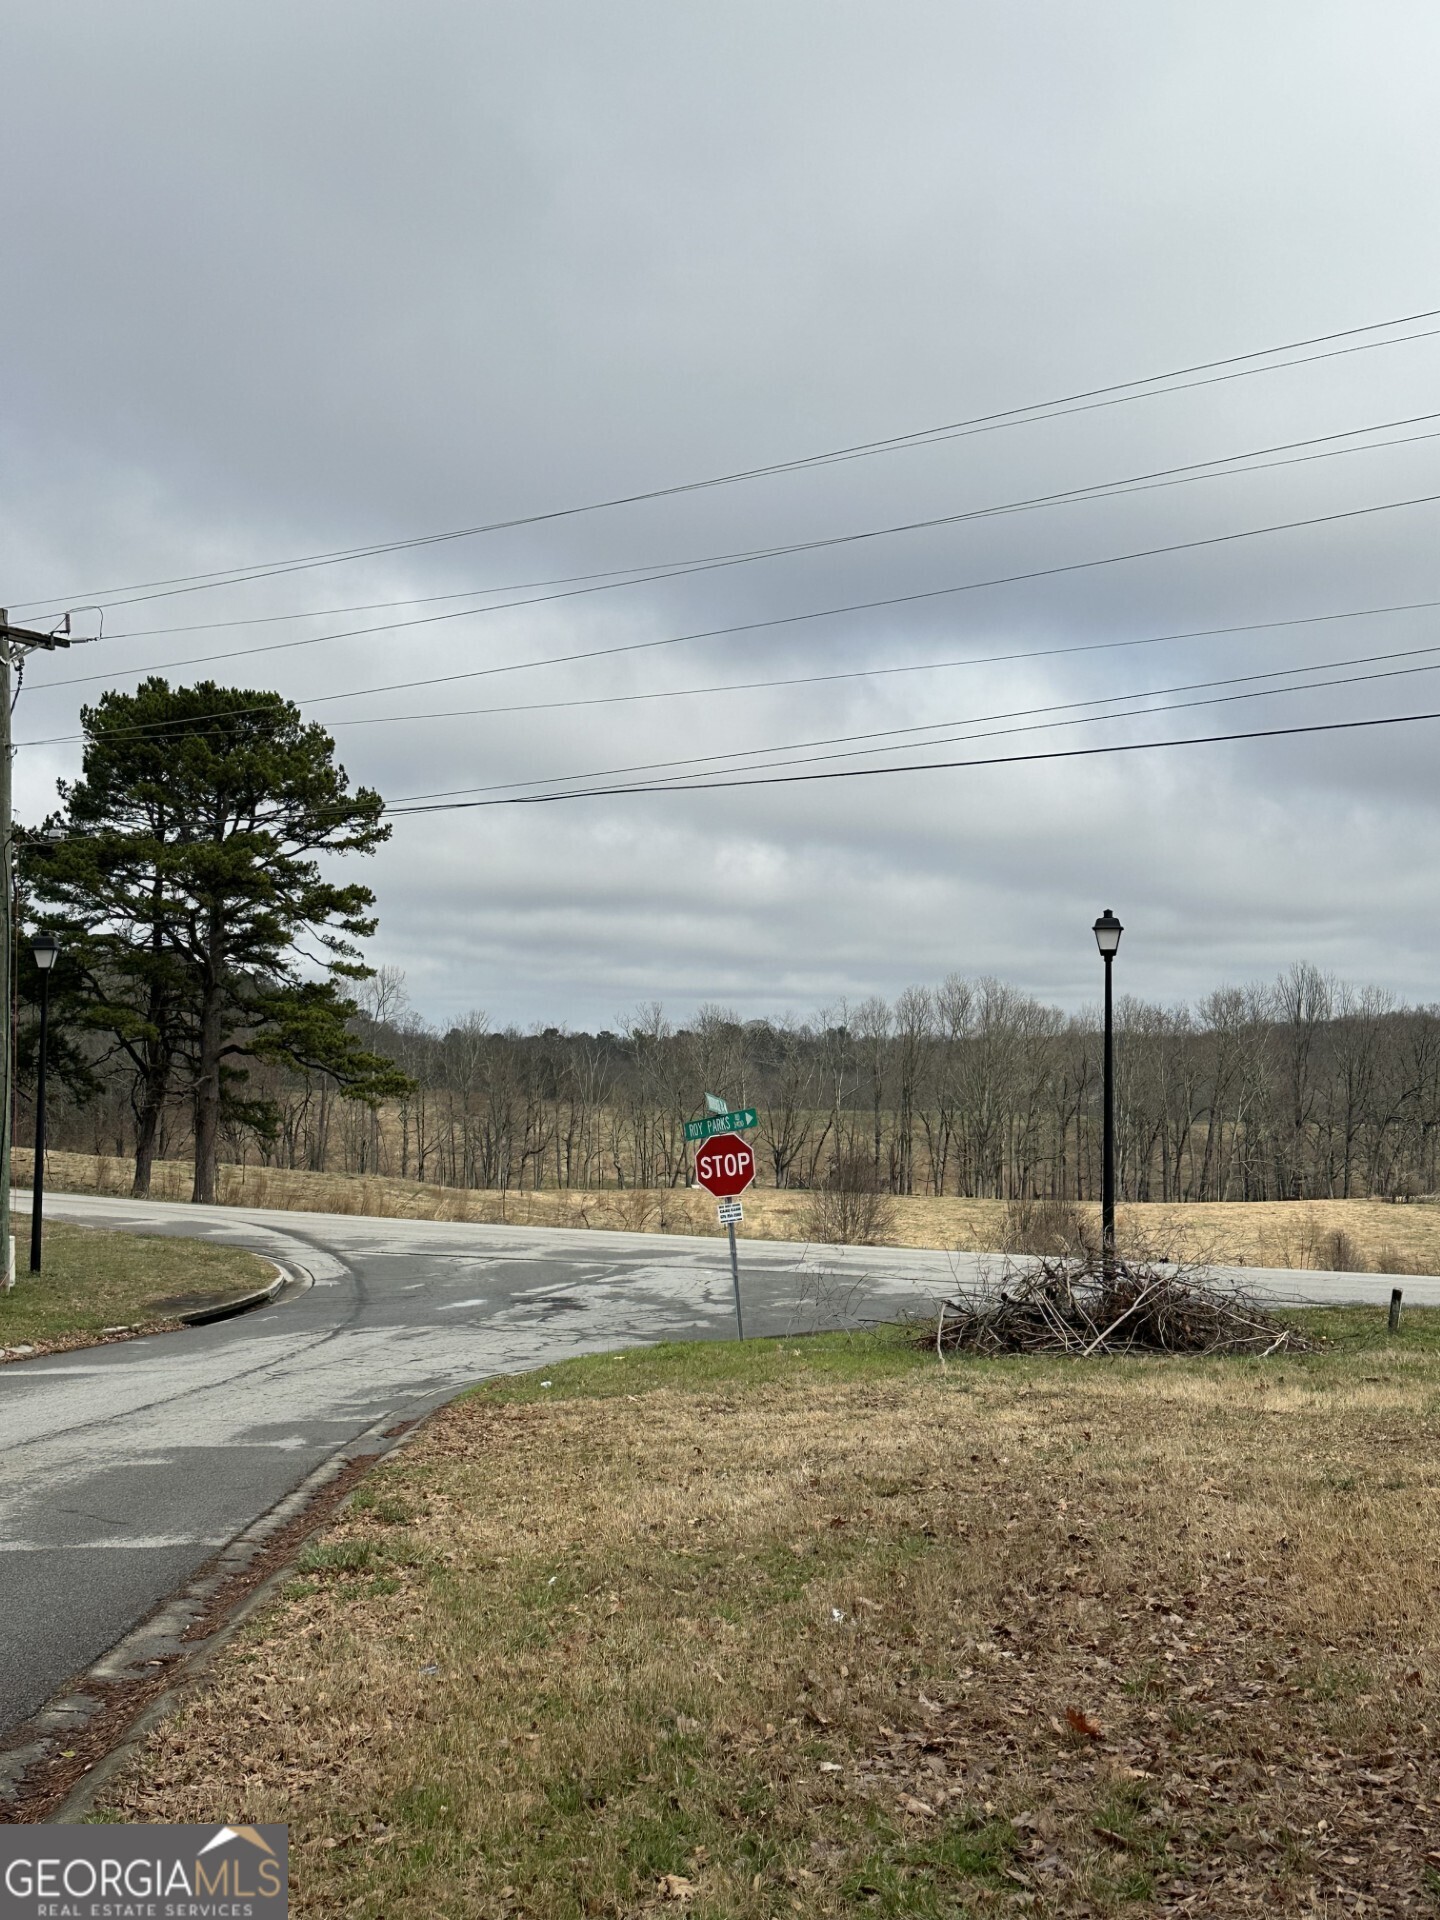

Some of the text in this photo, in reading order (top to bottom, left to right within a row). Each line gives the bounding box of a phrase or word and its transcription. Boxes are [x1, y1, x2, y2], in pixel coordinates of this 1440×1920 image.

[689, 1122, 703, 1137] ROY
[707, 1116, 731, 1133] PARKS
[700, 1152, 750, 1179] STOP
